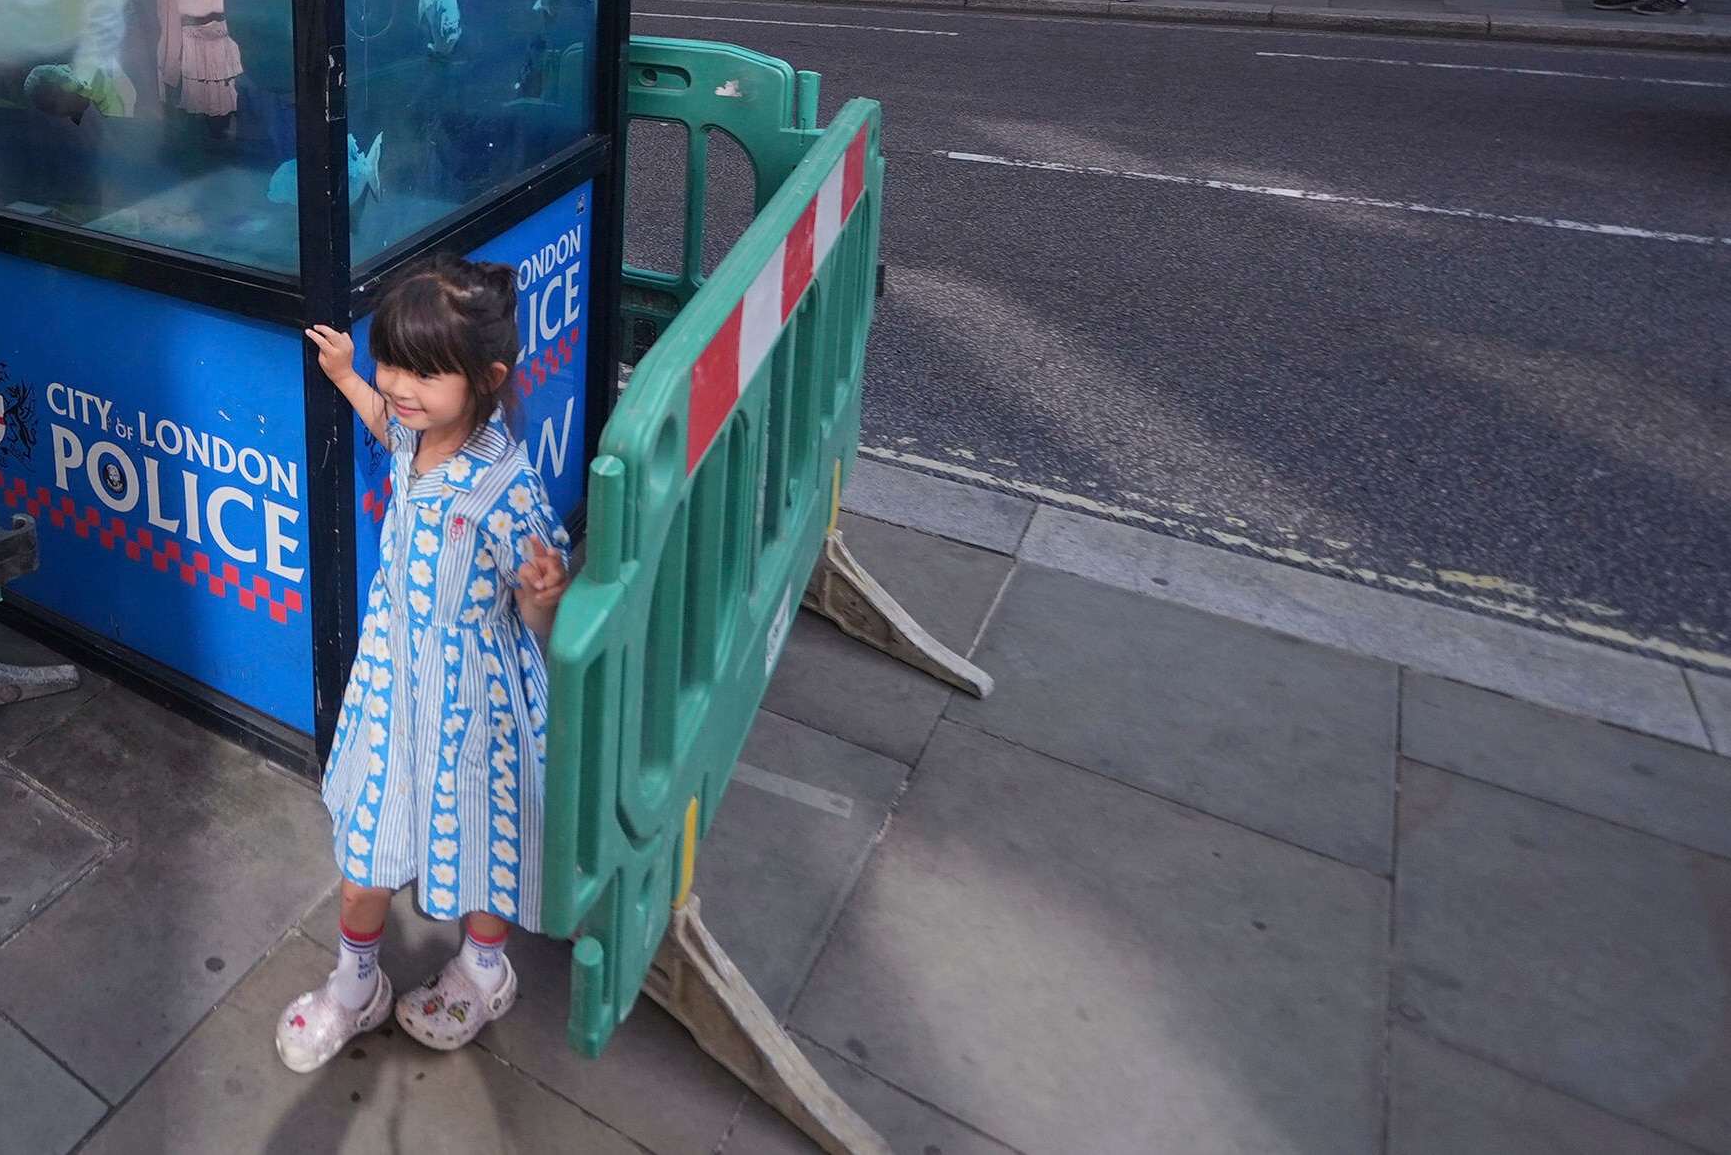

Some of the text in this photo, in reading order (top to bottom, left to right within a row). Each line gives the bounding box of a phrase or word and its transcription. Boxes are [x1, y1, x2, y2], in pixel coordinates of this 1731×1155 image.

[515, 260, 581, 366] ICE
[517, 224, 582, 292] ONDON
[46, 382, 299, 500] CITY OF LONDON
[50, 423, 305, 584] POLICE
